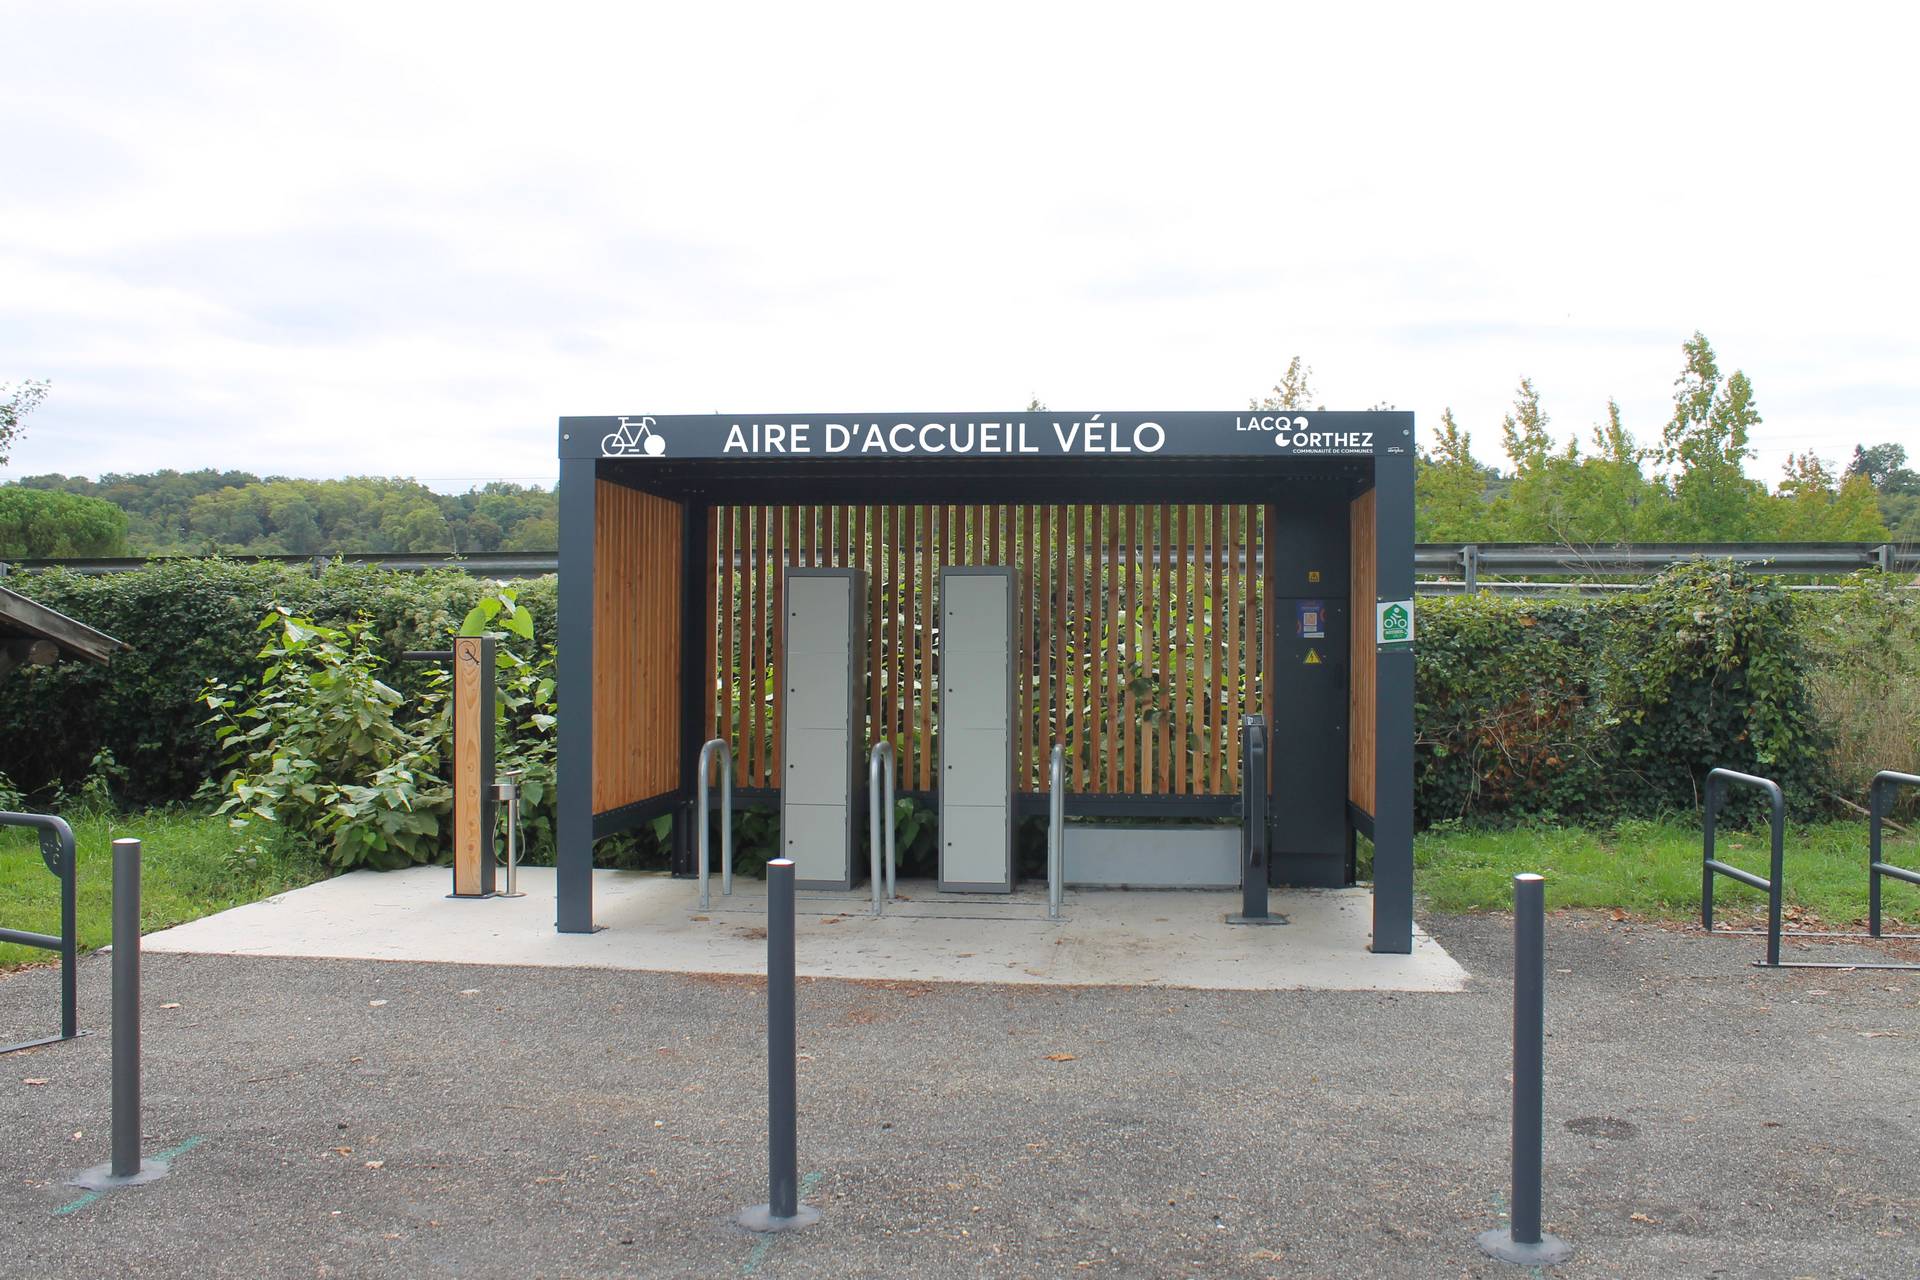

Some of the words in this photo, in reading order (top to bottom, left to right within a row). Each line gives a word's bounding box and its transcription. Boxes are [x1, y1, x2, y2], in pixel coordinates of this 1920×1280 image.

[1236, 416, 1293, 431] LACQ
[723, 423, 809, 453] AIRE
[824, 422, 1039, 453] D'ACCUEIL
[1052, 413, 1166, 453] VÉLO
[1292, 432, 1373, 447] ORTHEZ
